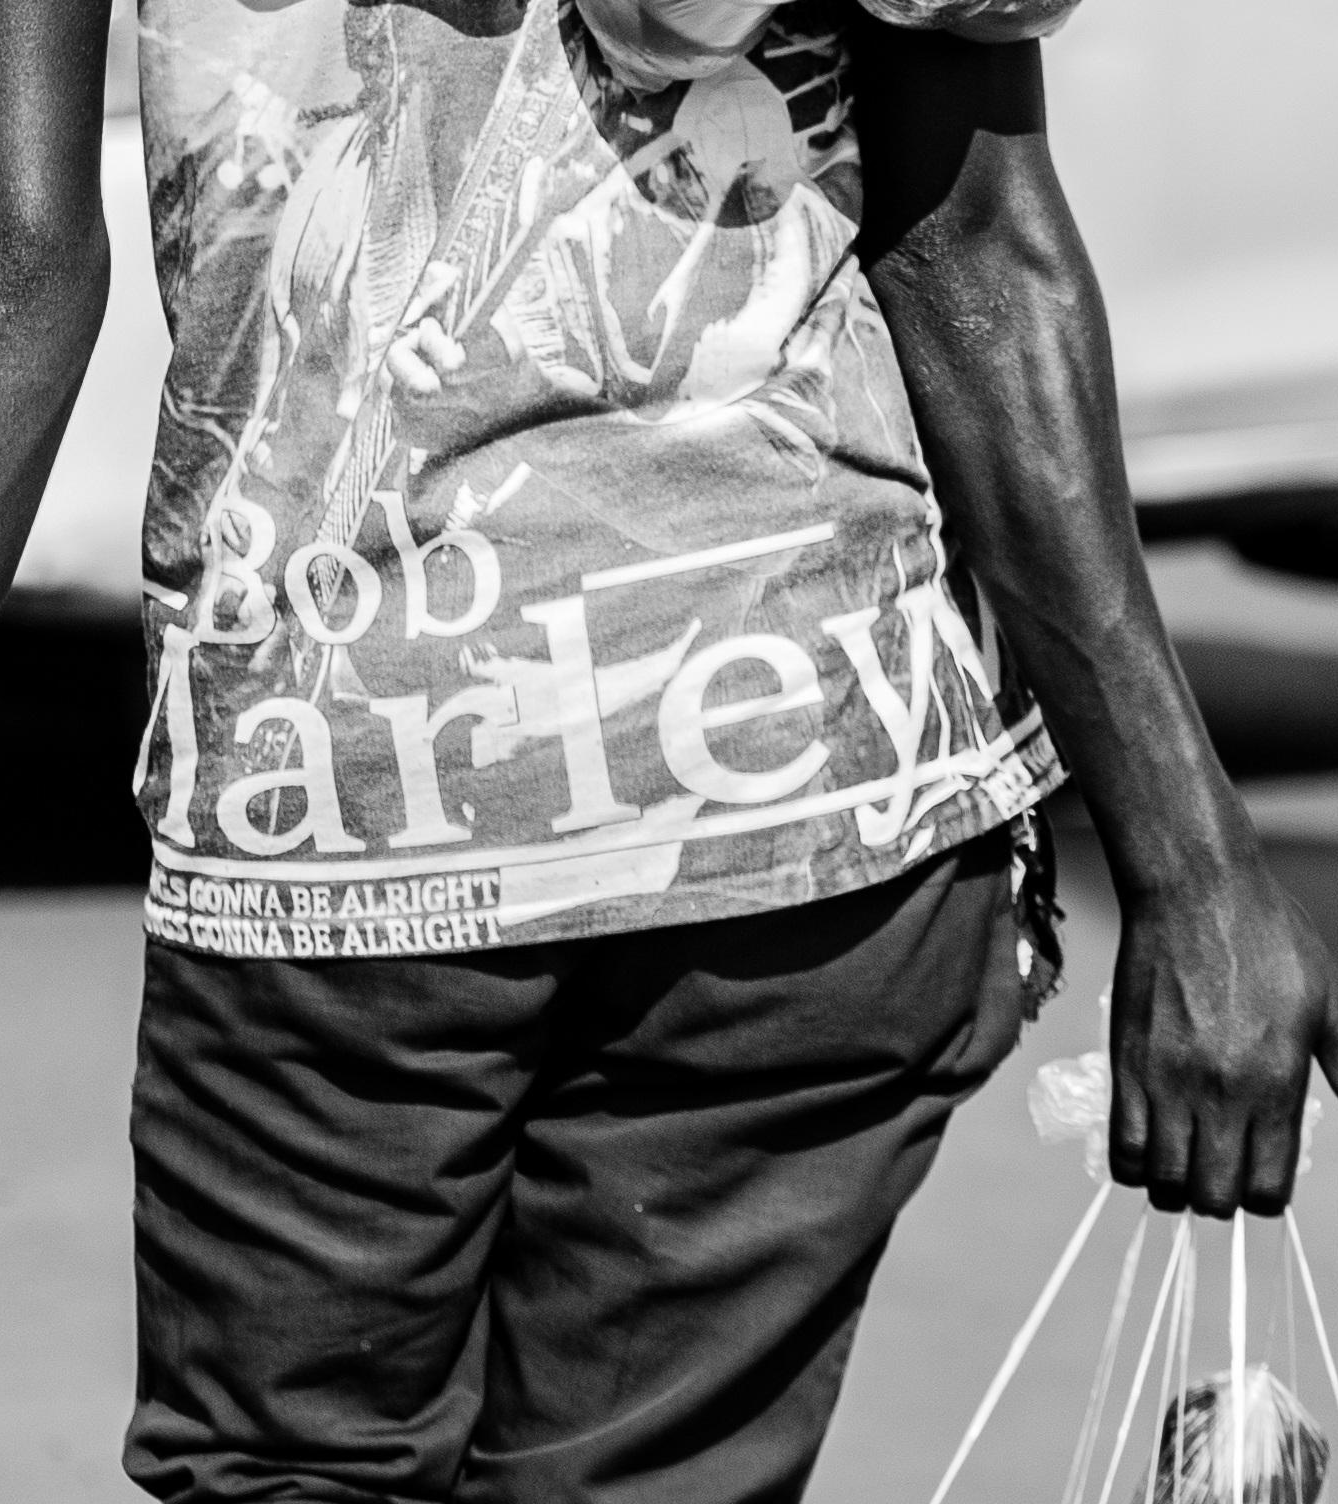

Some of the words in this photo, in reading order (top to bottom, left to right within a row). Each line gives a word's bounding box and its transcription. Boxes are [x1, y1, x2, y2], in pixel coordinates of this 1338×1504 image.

[193, 489, 502, 645] Bob
[189, 877, 286, 919] GONNA
[291, 884, 333, 919] BE
[336, 872, 500, 920] ALRIGHT
[189, 914, 289, 957] GONNA
[292, 922, 336, 957] BE
[340, 911, 502, 956] ALRIGHT
